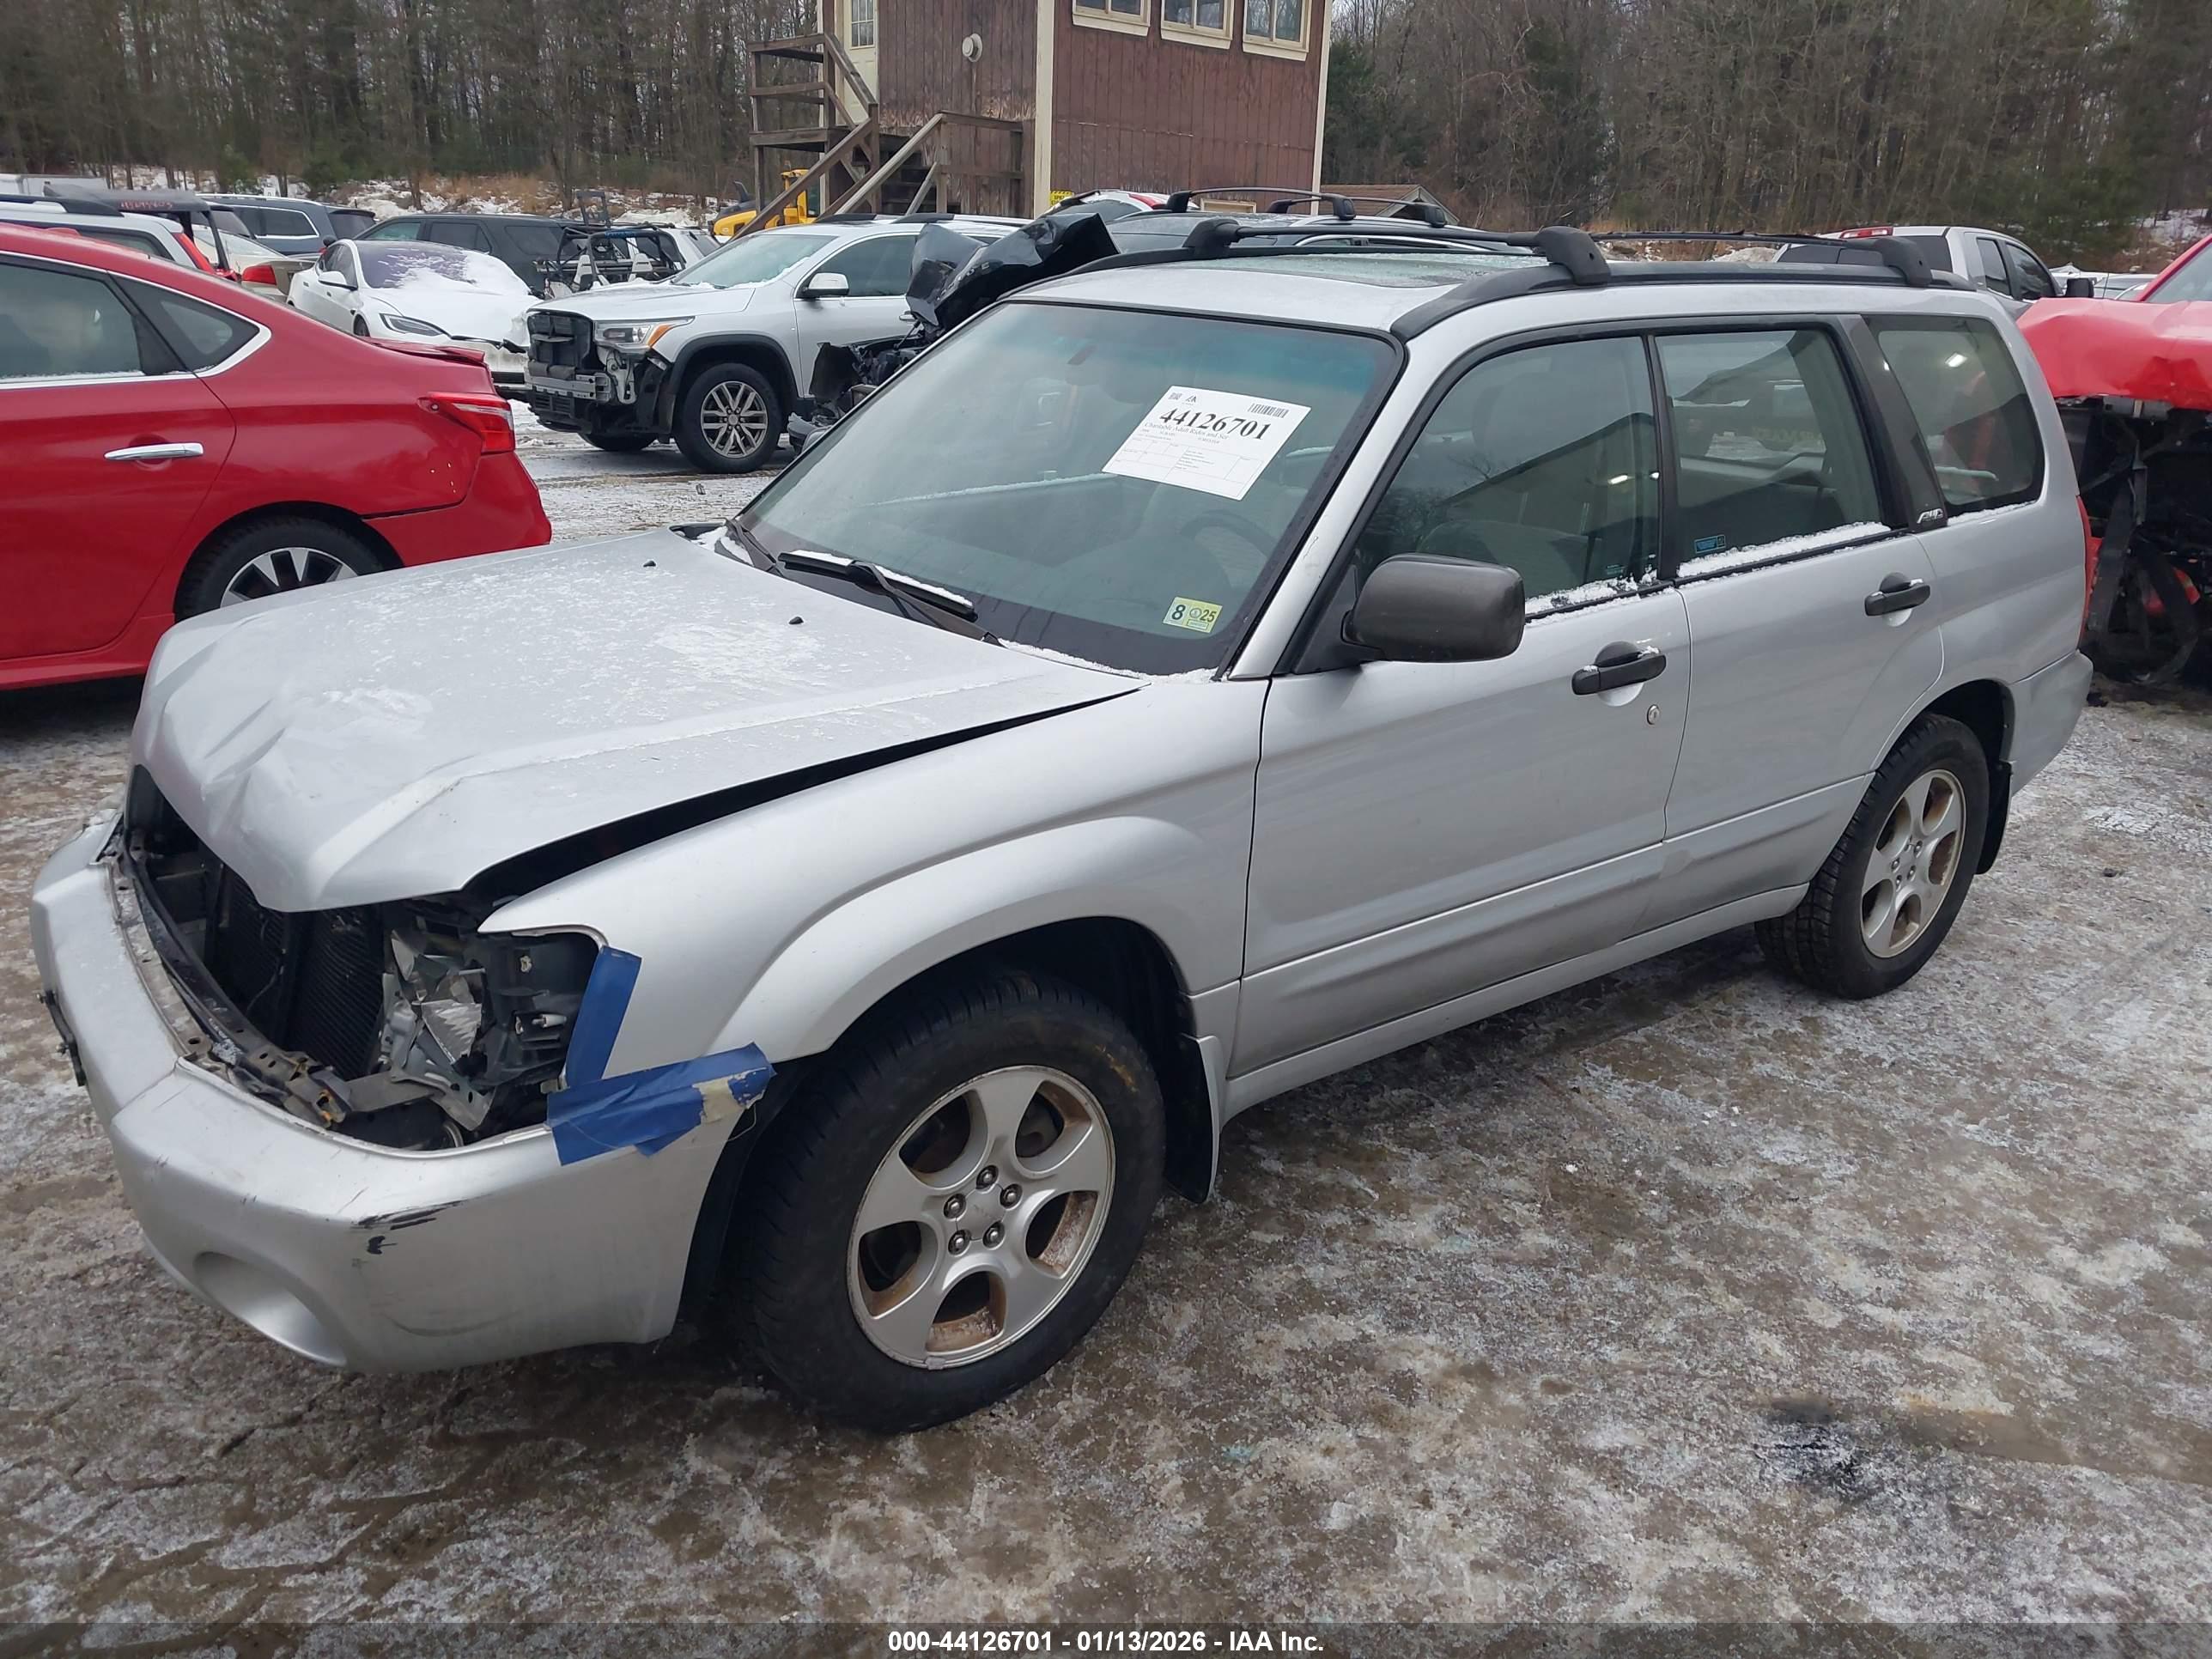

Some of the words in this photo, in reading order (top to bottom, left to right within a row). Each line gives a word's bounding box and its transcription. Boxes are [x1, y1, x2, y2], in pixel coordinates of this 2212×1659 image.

[1159, 408, 1272, 441] 44126701
[1172, 605, 1186, 620] 8
[1200, 610, 1217, 623] 25
